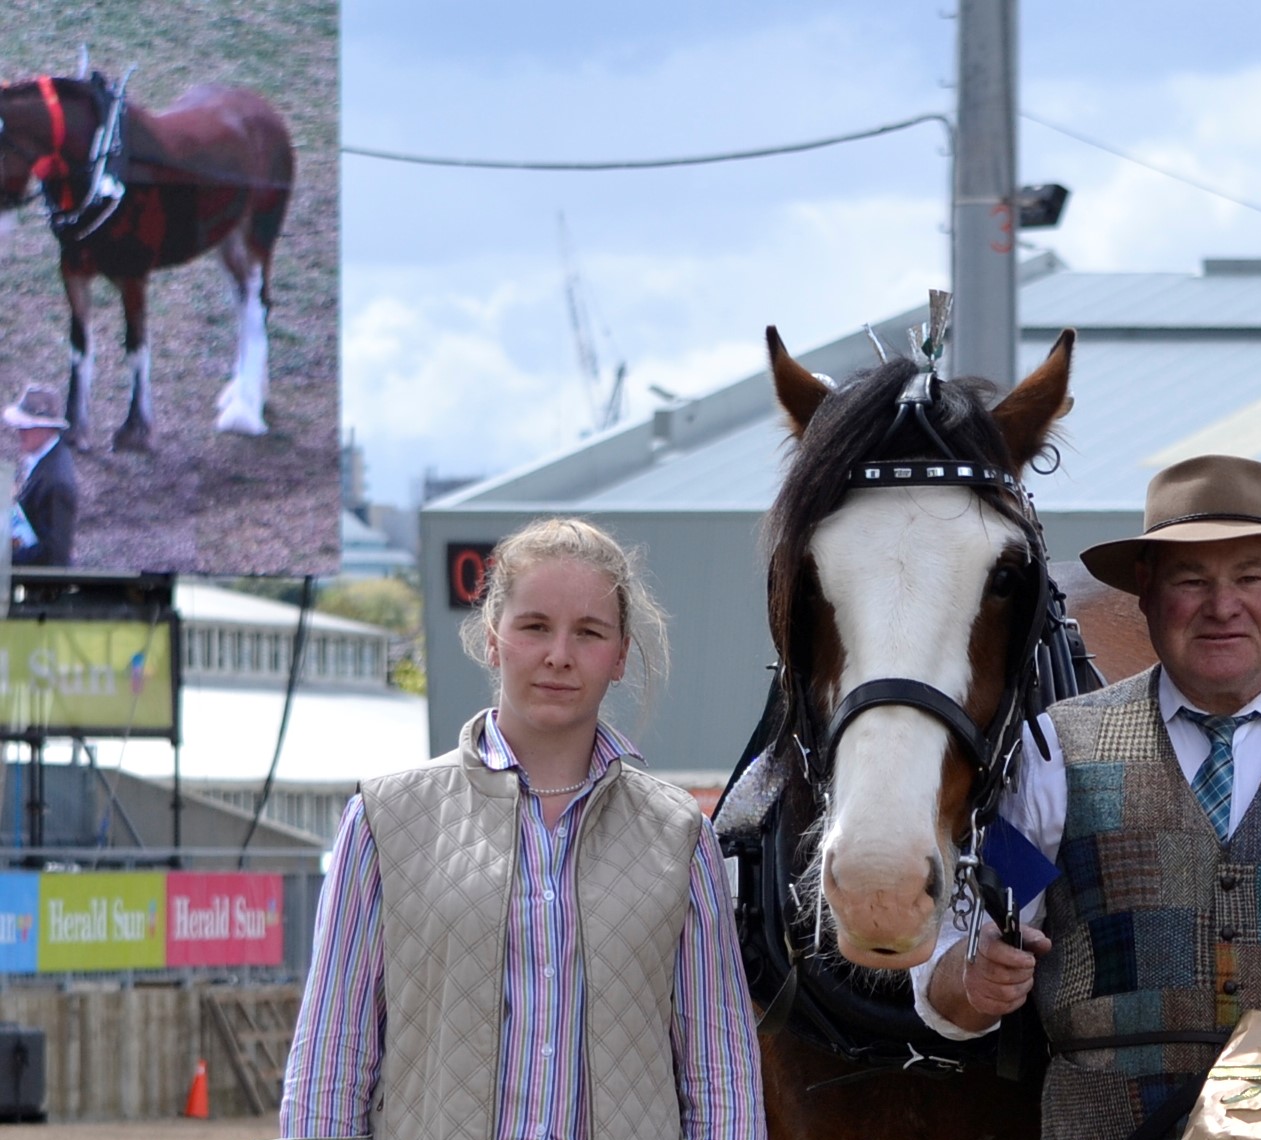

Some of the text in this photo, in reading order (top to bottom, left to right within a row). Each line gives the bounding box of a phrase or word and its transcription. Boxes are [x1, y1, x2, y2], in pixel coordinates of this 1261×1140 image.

[28, 648, 117, 695] Sun
[48, 897, 145, 943] Herald Sun
[174, 895, 266, 940] Herald Sun
